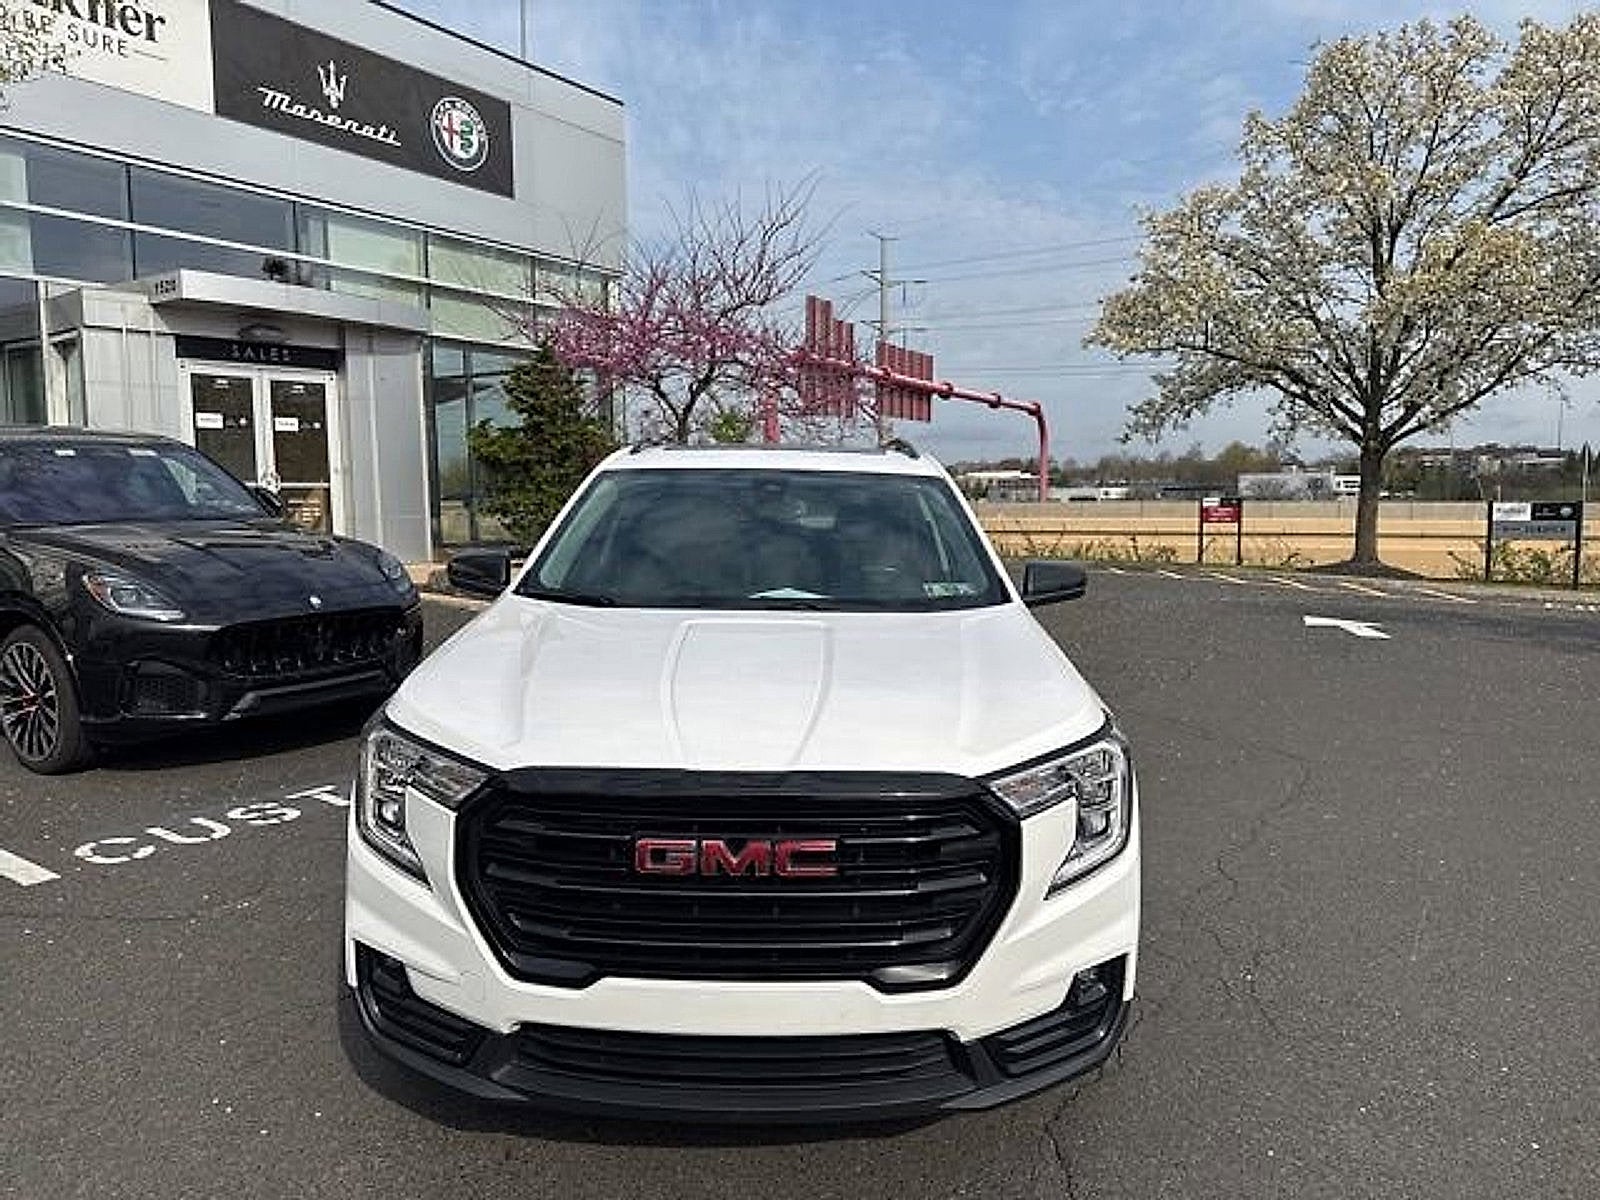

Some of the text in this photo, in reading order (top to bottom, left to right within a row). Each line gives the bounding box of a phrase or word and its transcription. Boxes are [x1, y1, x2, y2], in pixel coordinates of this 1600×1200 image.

[66, 23, 129, 58] SURE
[257, 86, 402, 147] Maserati
[73, 784, 351, 864] CUST
[634, 837, 838, 877] GMC
